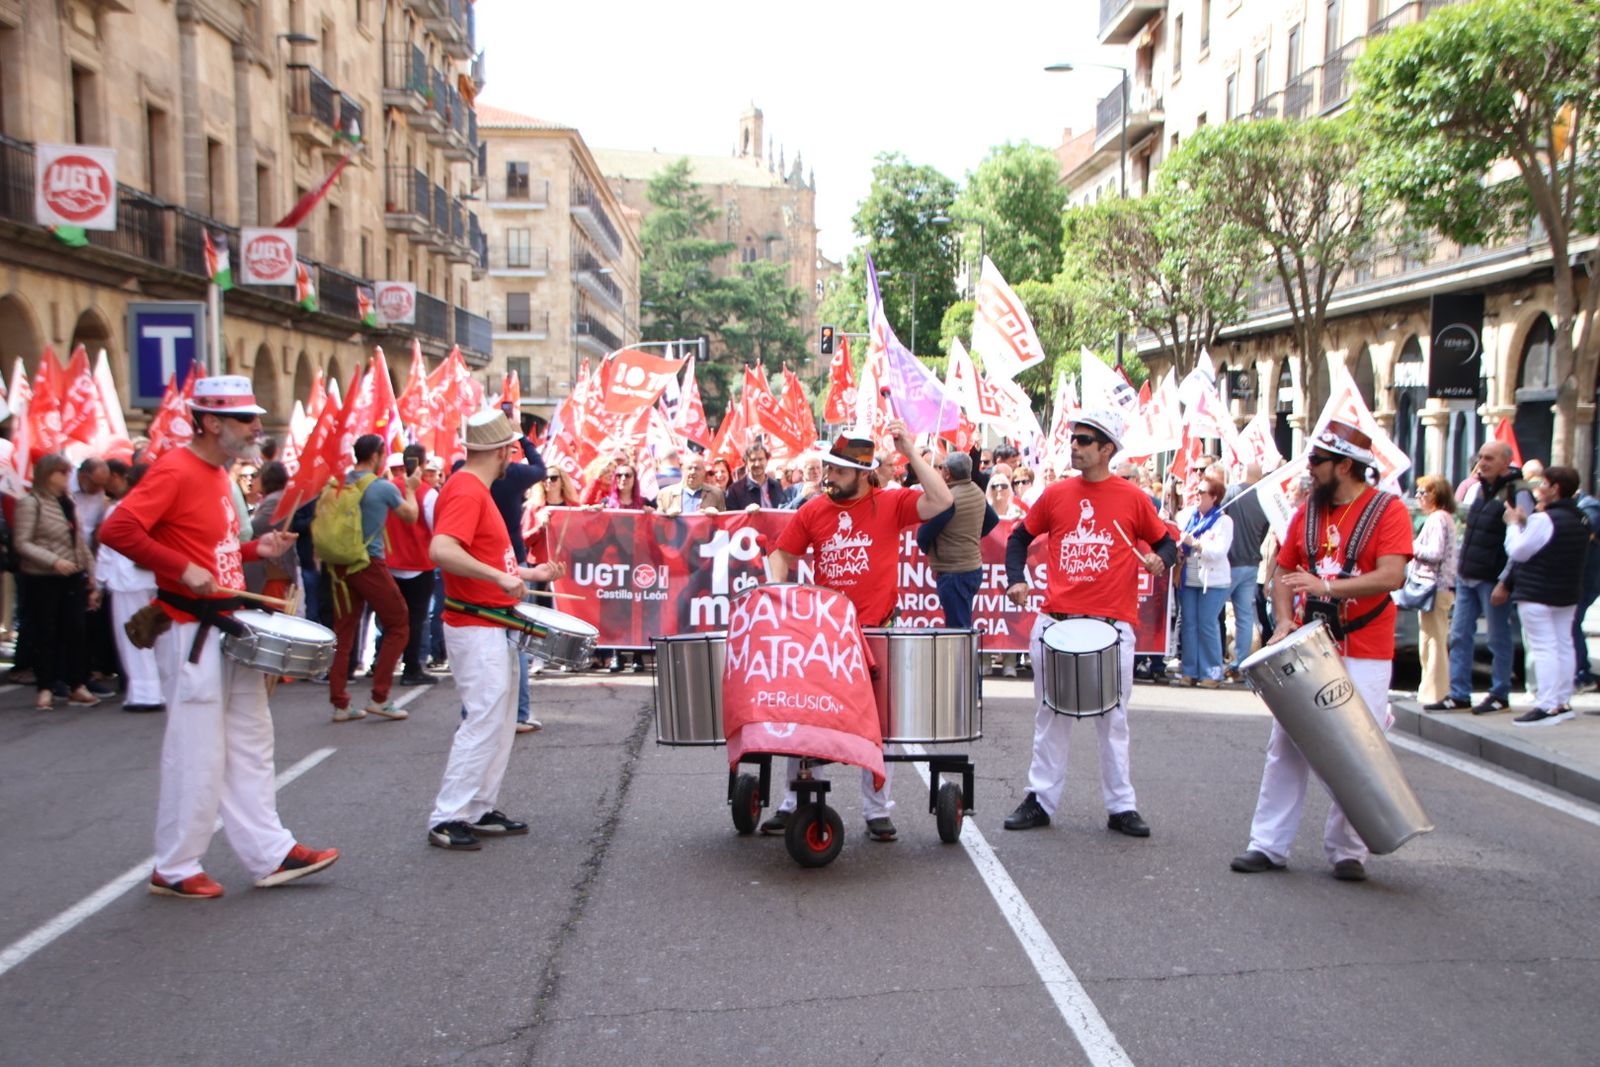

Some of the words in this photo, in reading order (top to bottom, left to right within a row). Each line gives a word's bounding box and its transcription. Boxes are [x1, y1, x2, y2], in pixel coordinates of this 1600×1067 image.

[51, 164, 103, 195] UGT
[251, 241, 288, 261] UGT
[142, 326, 193, 386] T
[1061, 544, 1109, 561] BATUKA
[574, 563, 630, 587] UGT
[819, 560, 869, 579] MATRAKA
[1060, 558, 1109, 575] MATRAKA
[596, 588, 633, 600] Castilla
[635, 591, 642, 602] y
[644, 586, 668, 600] León
[729, 585, 863, 649] BATUKA
[727, 632, 866, 685] MATRAKA
